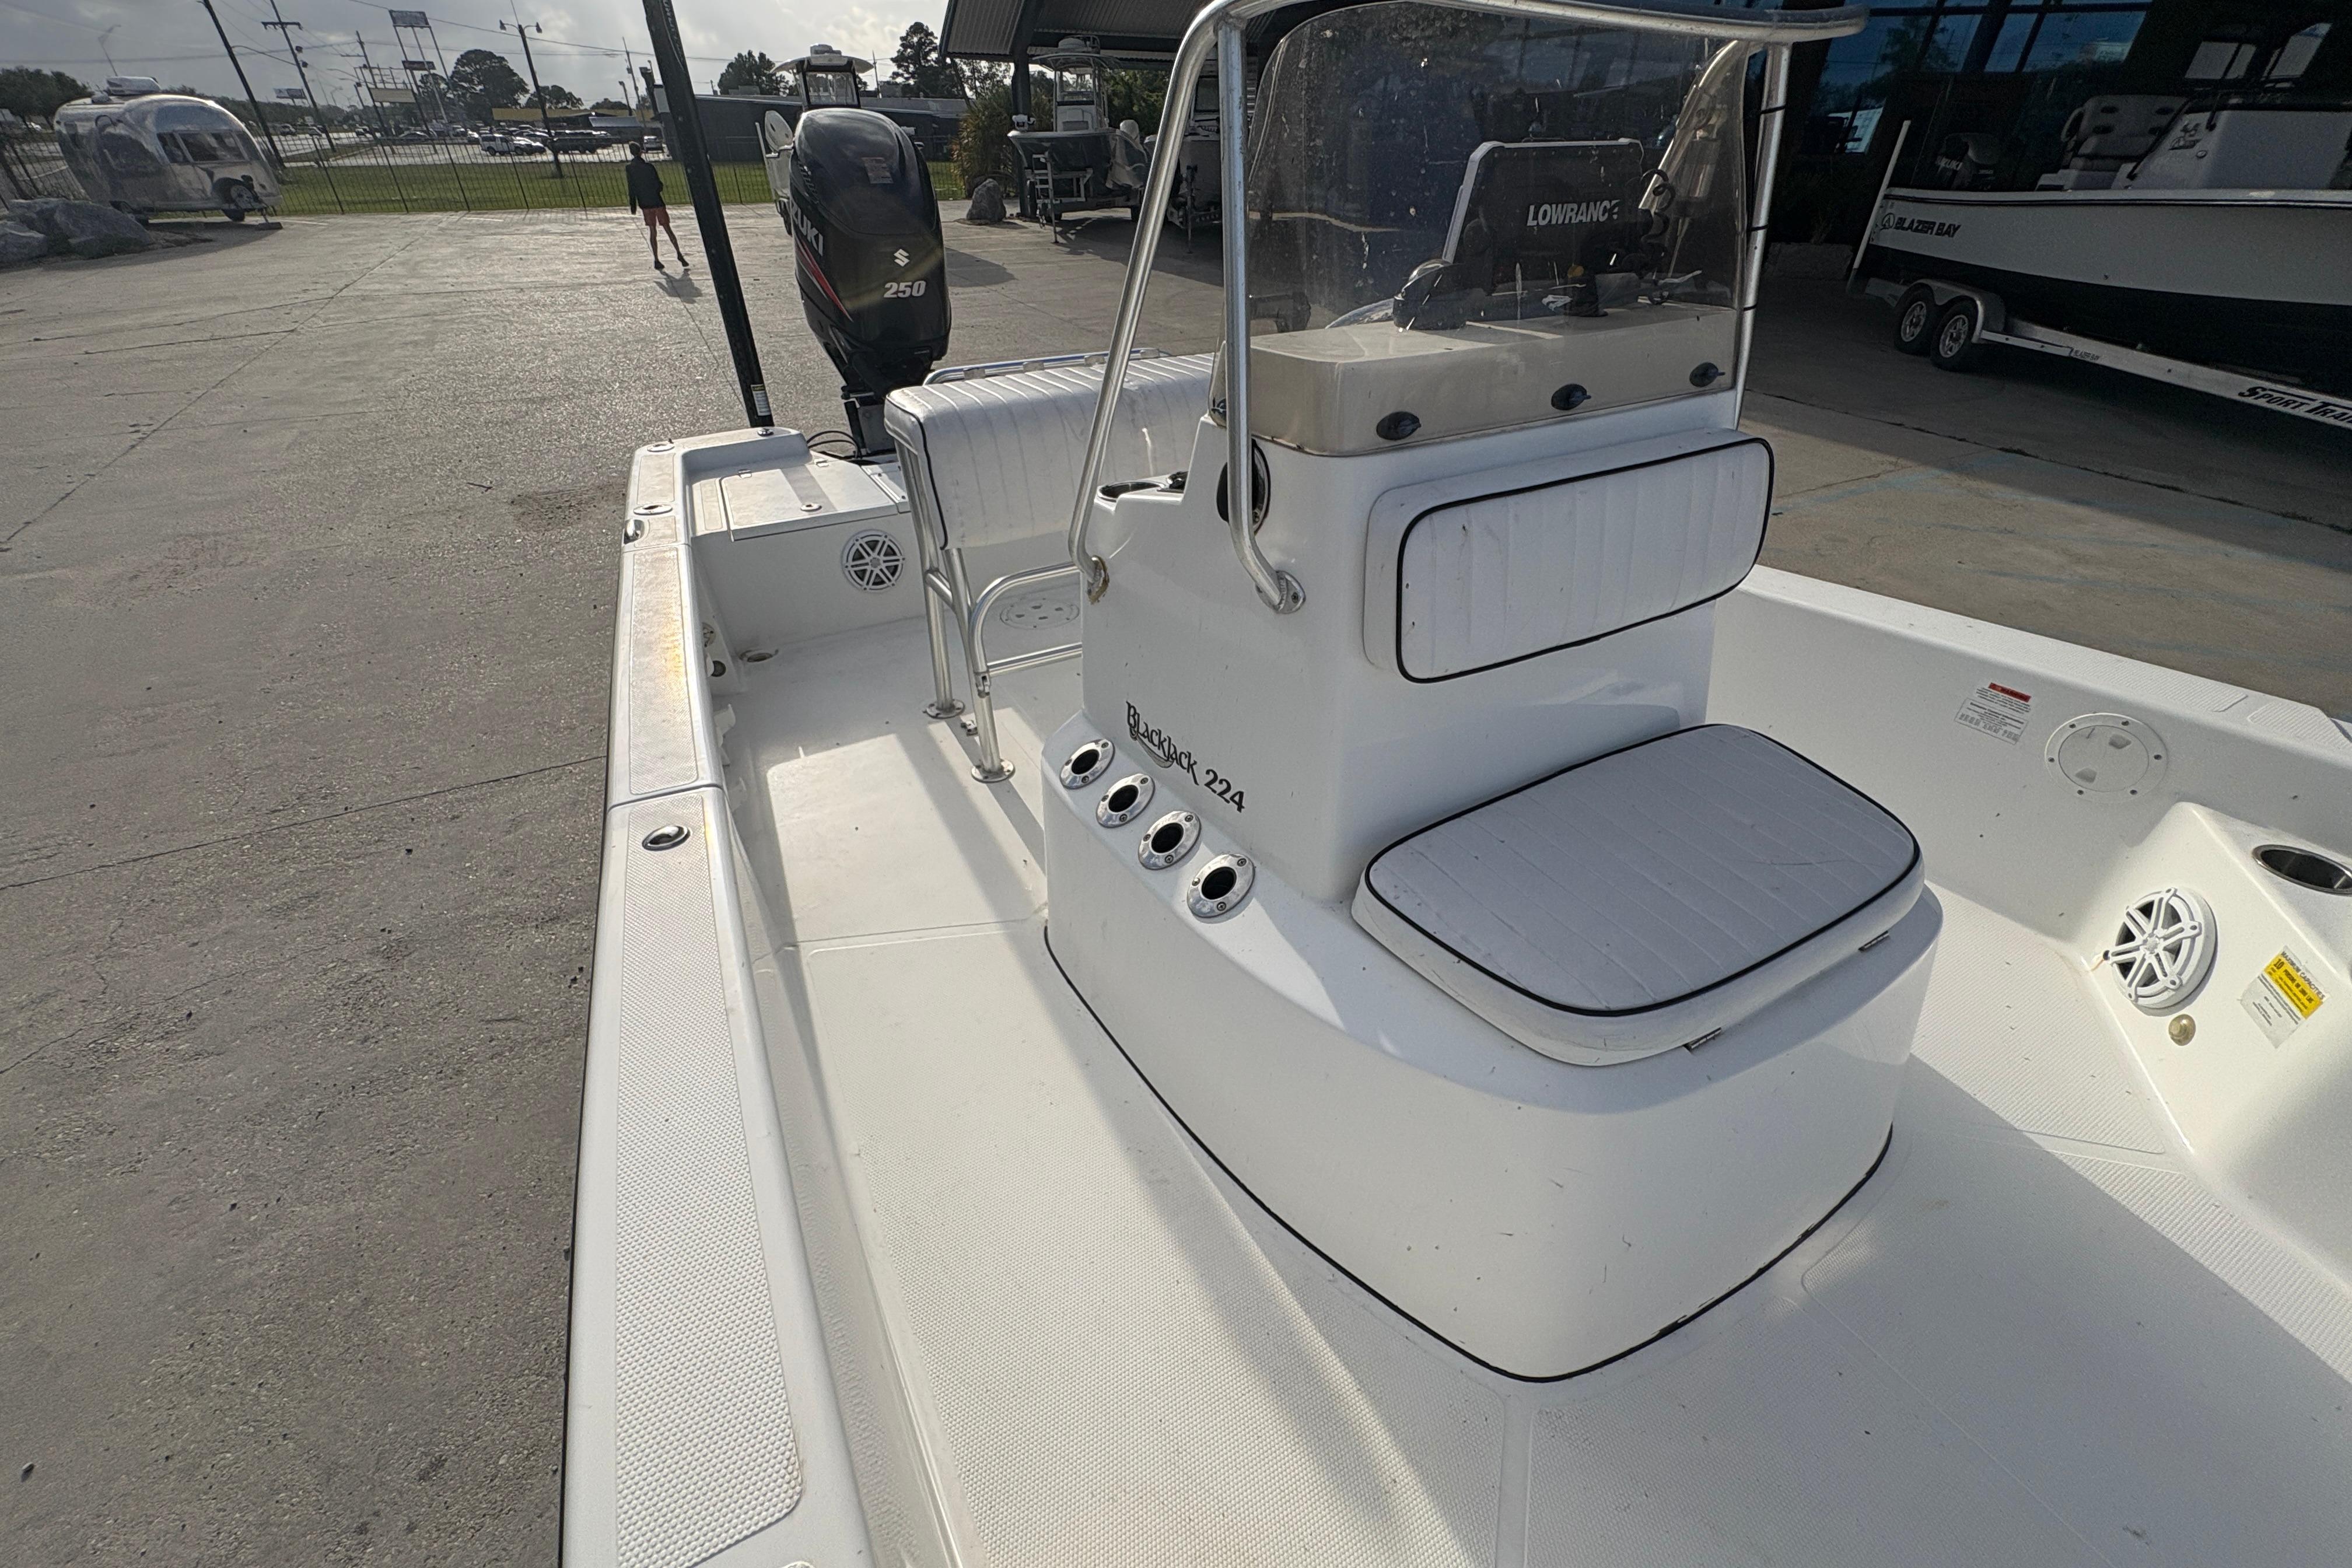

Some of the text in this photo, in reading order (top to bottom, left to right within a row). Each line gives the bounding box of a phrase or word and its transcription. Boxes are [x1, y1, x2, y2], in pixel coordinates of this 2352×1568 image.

[1894, 217, 1962, 239] BLAZER BAY
[884, 280, 926, 298] 250
[1204, 769, 1245, 813] 224
[2273, 958, 2285, 970] 10
[2300, 972, 2326, 1000] CAPACITIES
